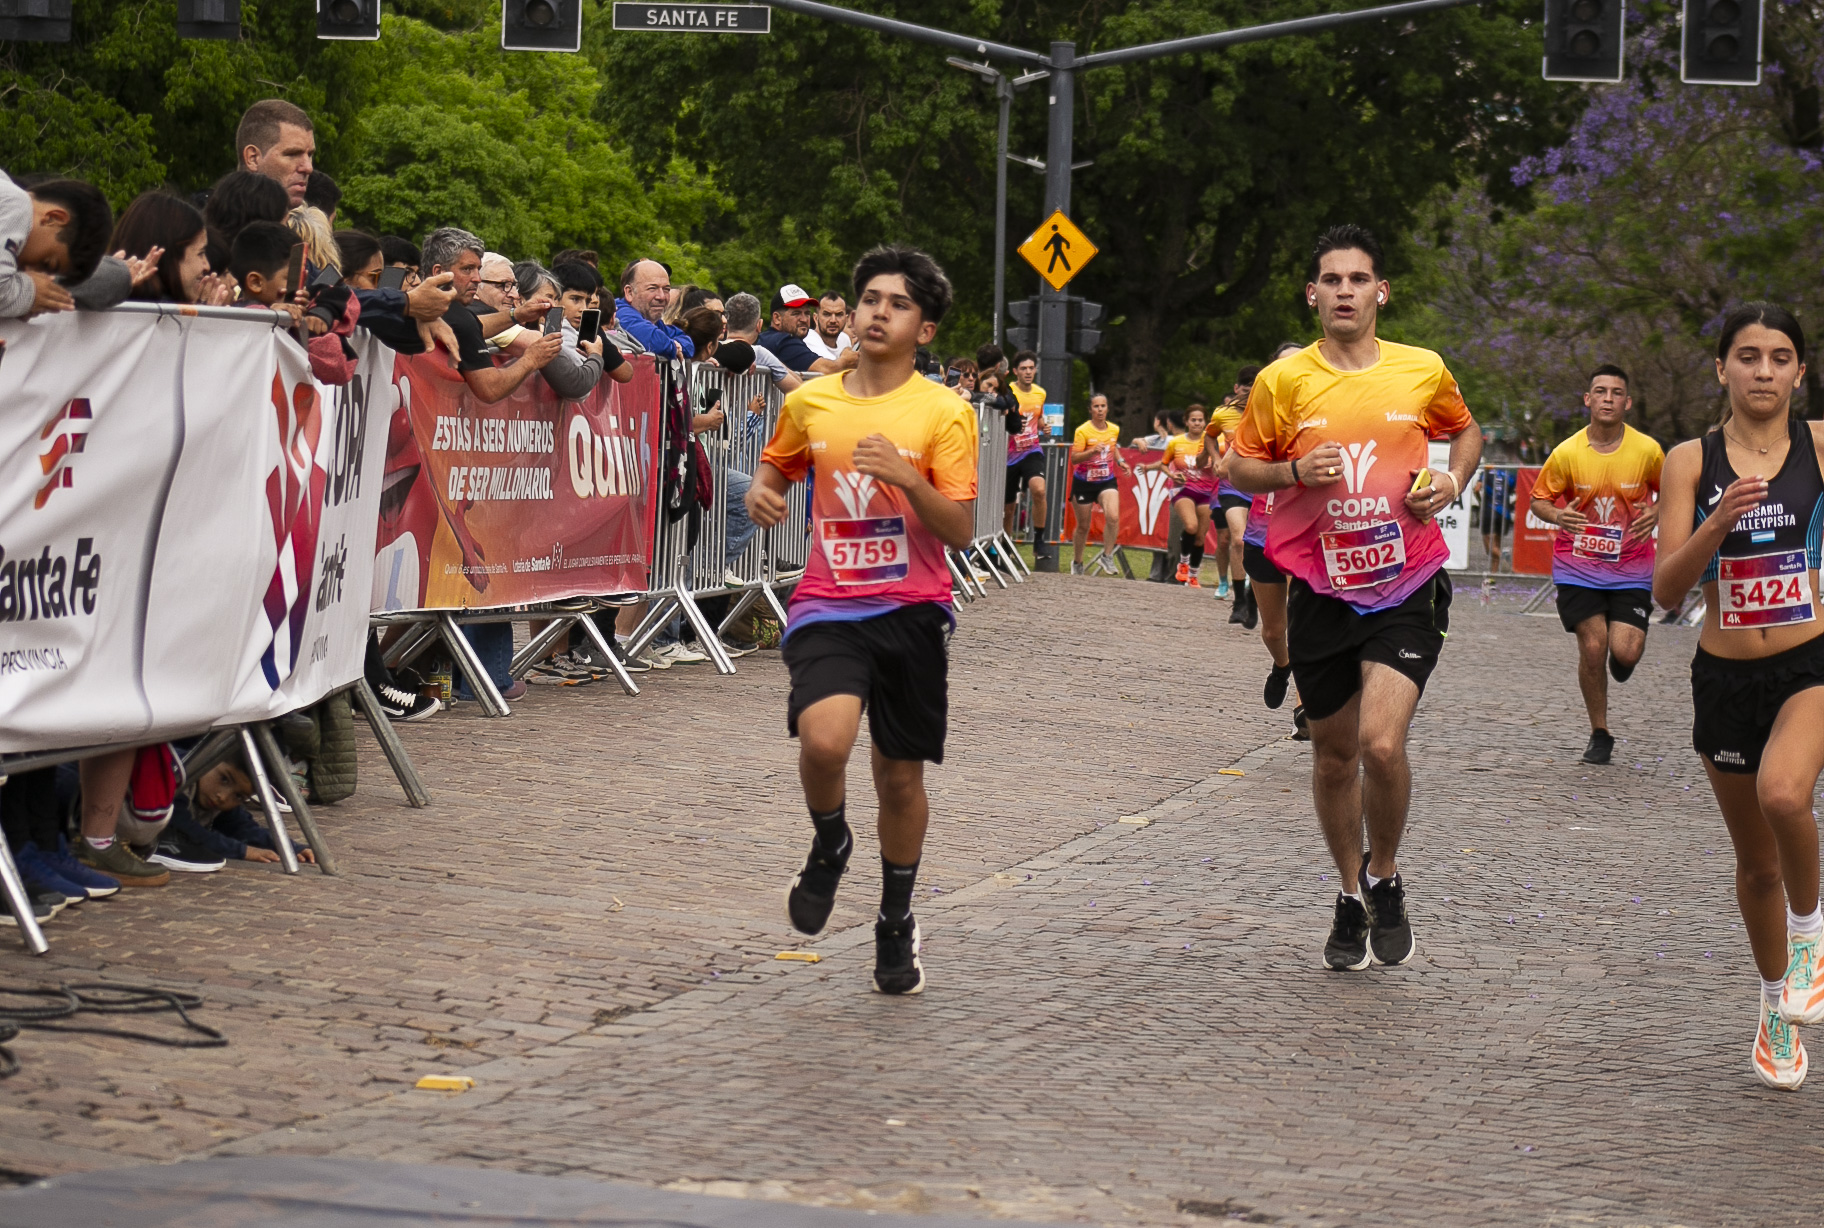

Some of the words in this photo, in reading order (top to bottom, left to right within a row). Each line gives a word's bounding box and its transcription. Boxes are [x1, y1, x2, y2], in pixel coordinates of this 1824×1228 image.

[647, 10, 709, 27] SANTA
[715, 11, 739, 27] FE
[432, 408, 472, 451] ESTÁS
[473, 418, 482, 452] A
[482, 418, 506, 453] SEIS
[506, 411, 555, 454] NÚMEROS
[568, 414, 641, 499] Quini
[449, 466, 468, 501] DE
[467, 467, 490, 501] SER
[487, 467, 554, 501] MILLONARIO.
[1326, 496, 1391, 518] COPA
[1334, 520, 1370, 530] Santa
[1731, 513, 1796, 533] ALLEYPISTA
[832, 538, 898, 566] 5759
[1580, 536, 1616, 553] 5960
[1335, 543, 1397, 573] 5602
[0, 544, 68, 623] anta
[70, 537, 101, 616] Fe
[1335, 576, 1348, 586] 4k
[1730, 576, 1802, 609] 5424
[1726, 613, 1741, 624] 4k
[0, 648, 69, 676] PROVINCIA
[1714, 755, 1745, 765] CALLEYPISTA
[1720, 750, 1740, 758] ROSARIO
